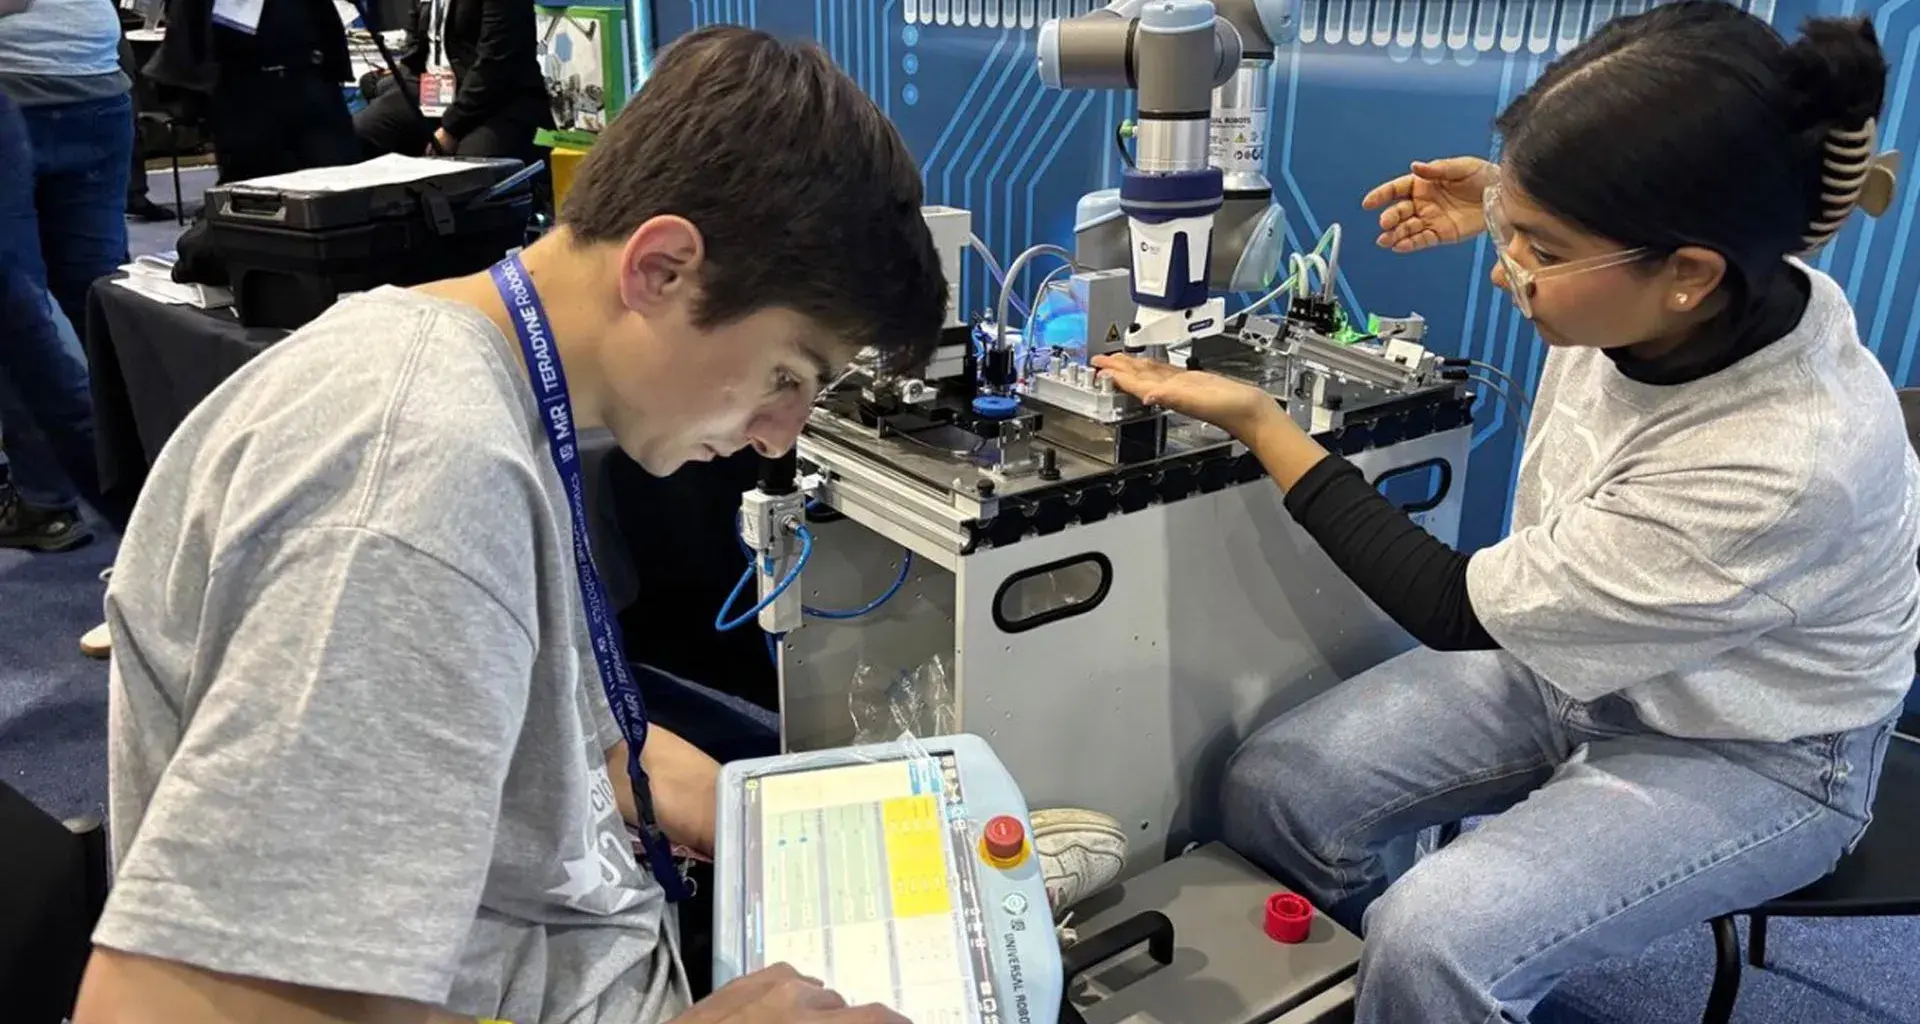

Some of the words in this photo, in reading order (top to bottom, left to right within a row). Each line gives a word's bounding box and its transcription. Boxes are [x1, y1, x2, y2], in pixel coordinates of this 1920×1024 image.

[502, 258, 532, 305] Robotic
[519, 306, 559, 392] TERADYNE
[550, 403, 571, 440] MiR
[1004, 932, 1023, 991] UNIVERSAL
